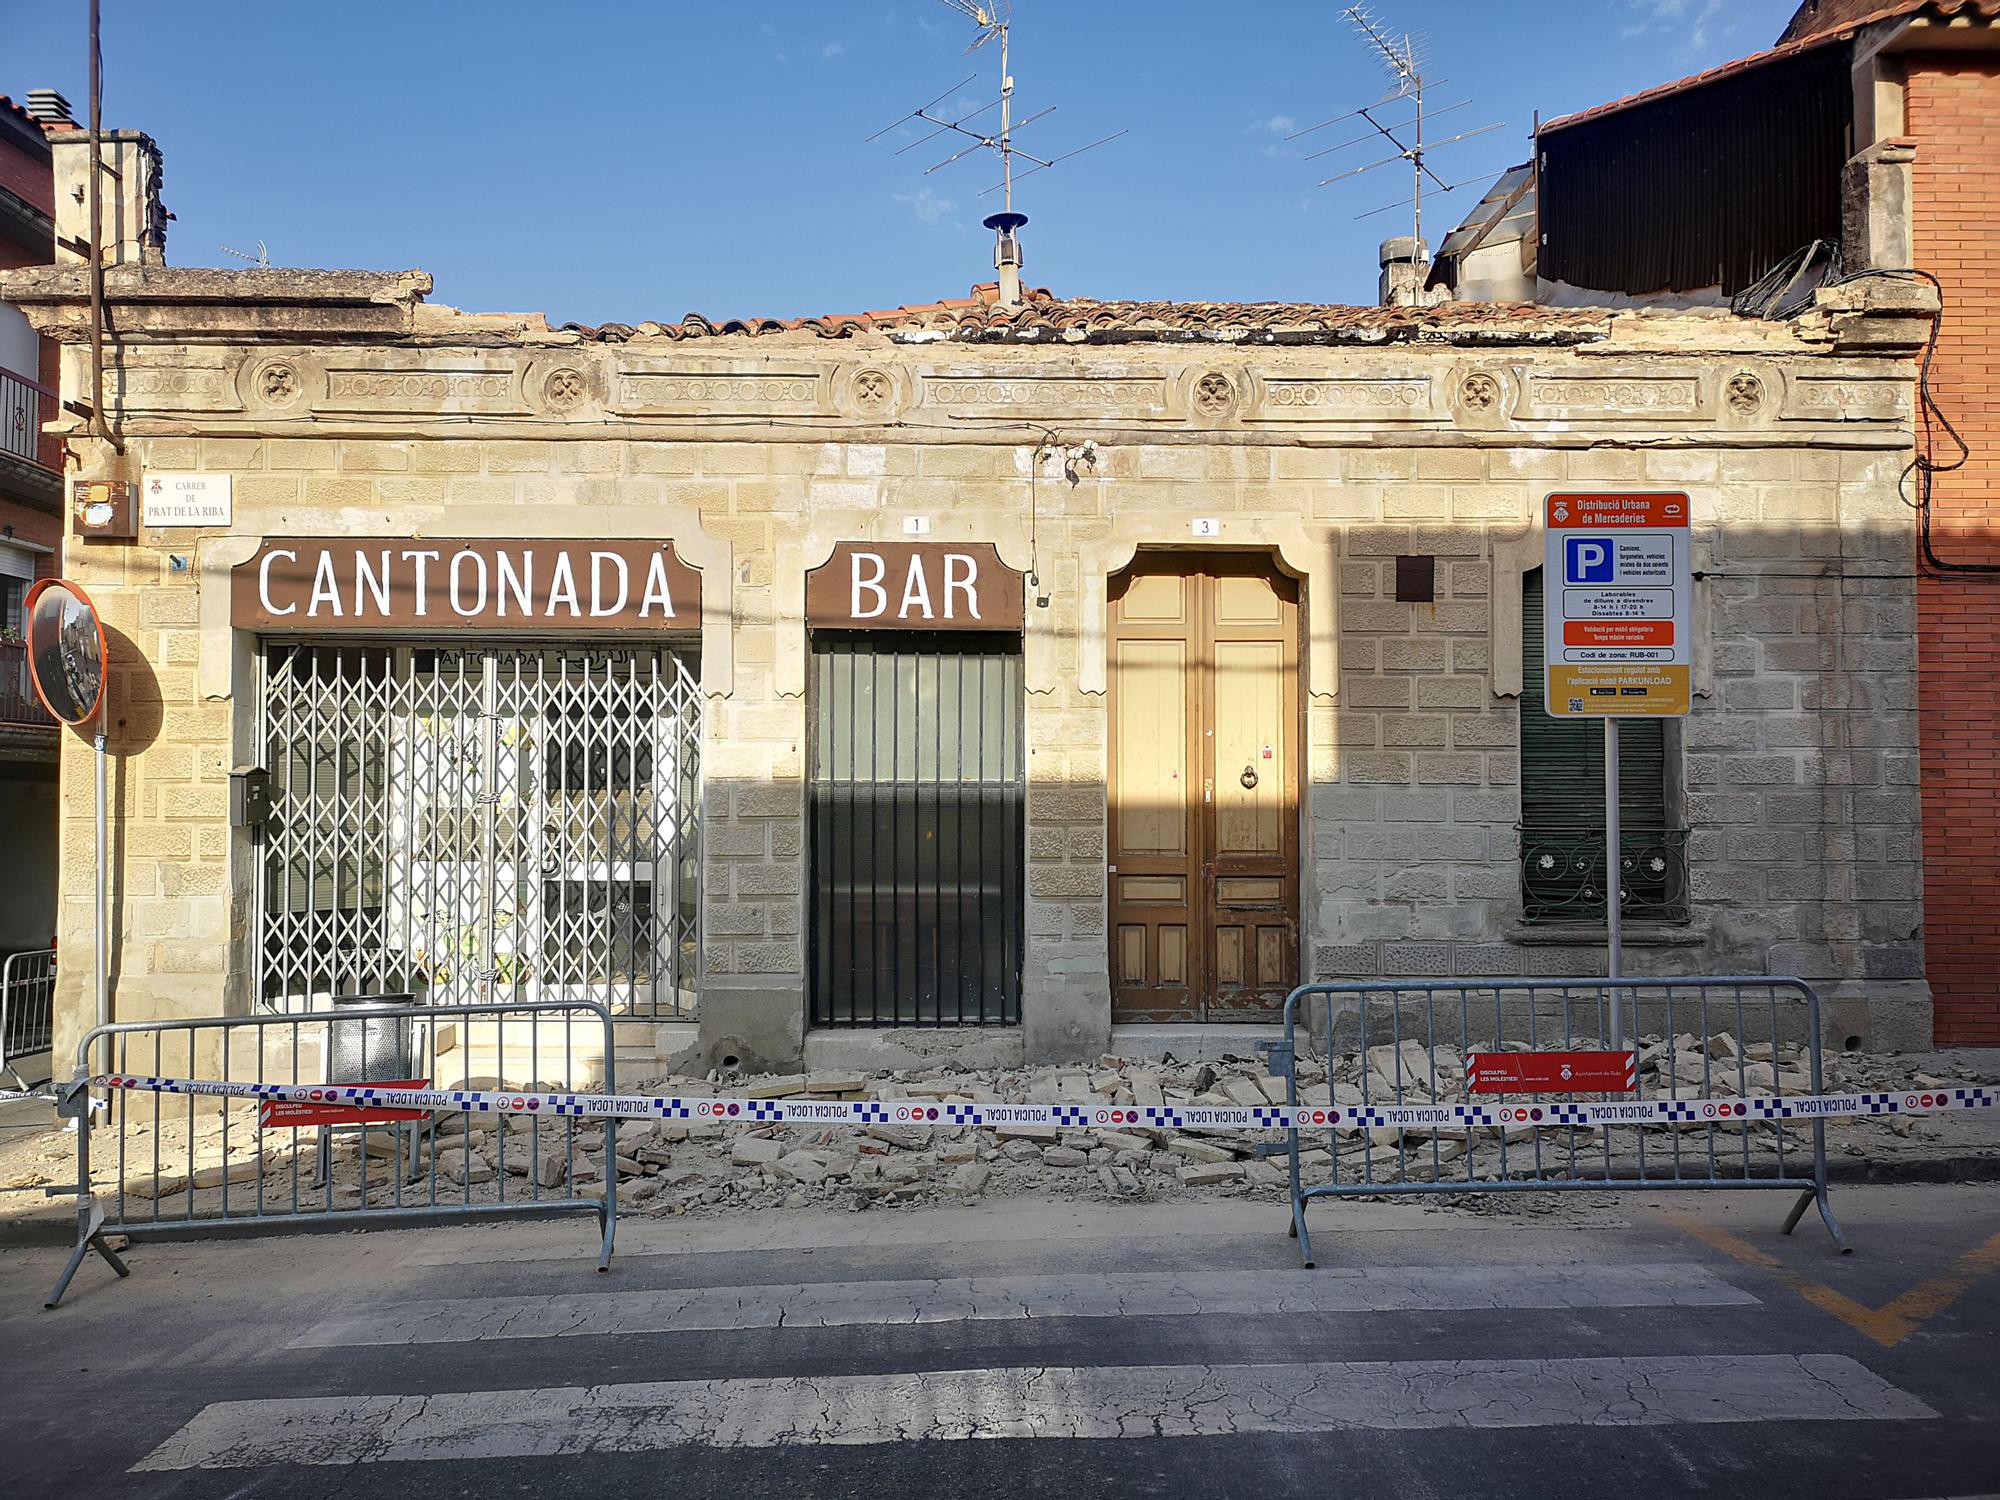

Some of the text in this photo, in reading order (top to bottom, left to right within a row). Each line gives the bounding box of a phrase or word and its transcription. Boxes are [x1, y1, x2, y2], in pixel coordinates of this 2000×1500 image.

[175, 482, 207, 490] CARRER
[186, 494, 196, 503] DE
[1578, 500, 1650, 510] Distribució Urbana
[148, 507, 224, 517] PRAT DE LA RIBA
[1583, 513, 1646, 524] de Mercaderies
[914, 518, 921, 532] 1
[1201, 520, 1210, 534] 3
[1578, 544, 1605, 579] P
[259, 549, 676, 618] CANTONADA
[850, 552, 982, 620] BAR
[1624, 666, 1646, 675] regulat
[1567, 677, 1598, 686] l'aplicació
[386, 1093, 447, 1106] POLICIA LOCAL
[1794, 1099, 1856, 1112] POLICIA LOCAL
[587, 1100, 648, 1112] POLICIA LOCAL
[786, 1105, 847, 1117] POLICIA LOCAL
[985, 1109, 1047, 1121] POLICIA LOCAL
[1185, 1112, 1247, 1122] POLICIA LOCAL
[1387, 1110, 1449, 1122] POLICIA LOCAL
[1590, 1106, 1653, 1119] POLICIA LOCAL
